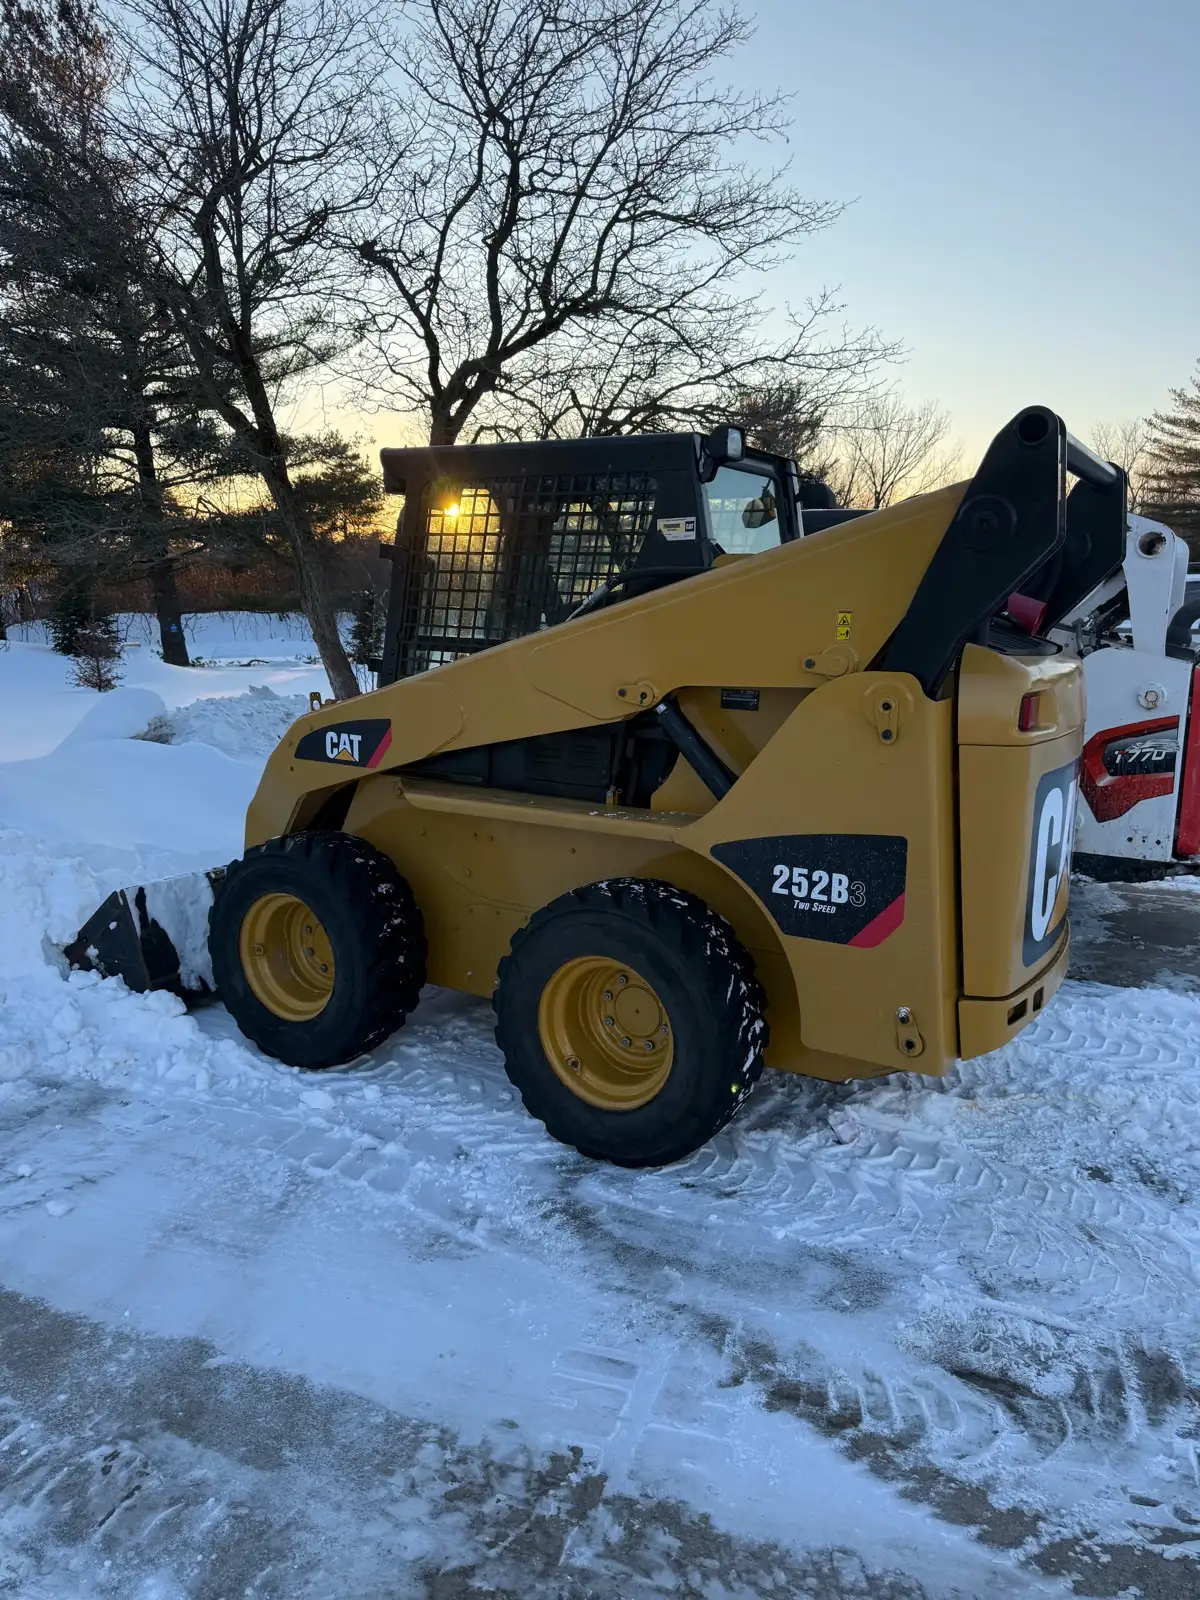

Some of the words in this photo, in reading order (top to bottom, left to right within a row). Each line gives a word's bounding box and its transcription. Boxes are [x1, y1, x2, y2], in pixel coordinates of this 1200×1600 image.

[325, 731, 362, 763] CAT
[1114, 747, 1167, 764] T770
[1031, 777, 1080, 942] CA
